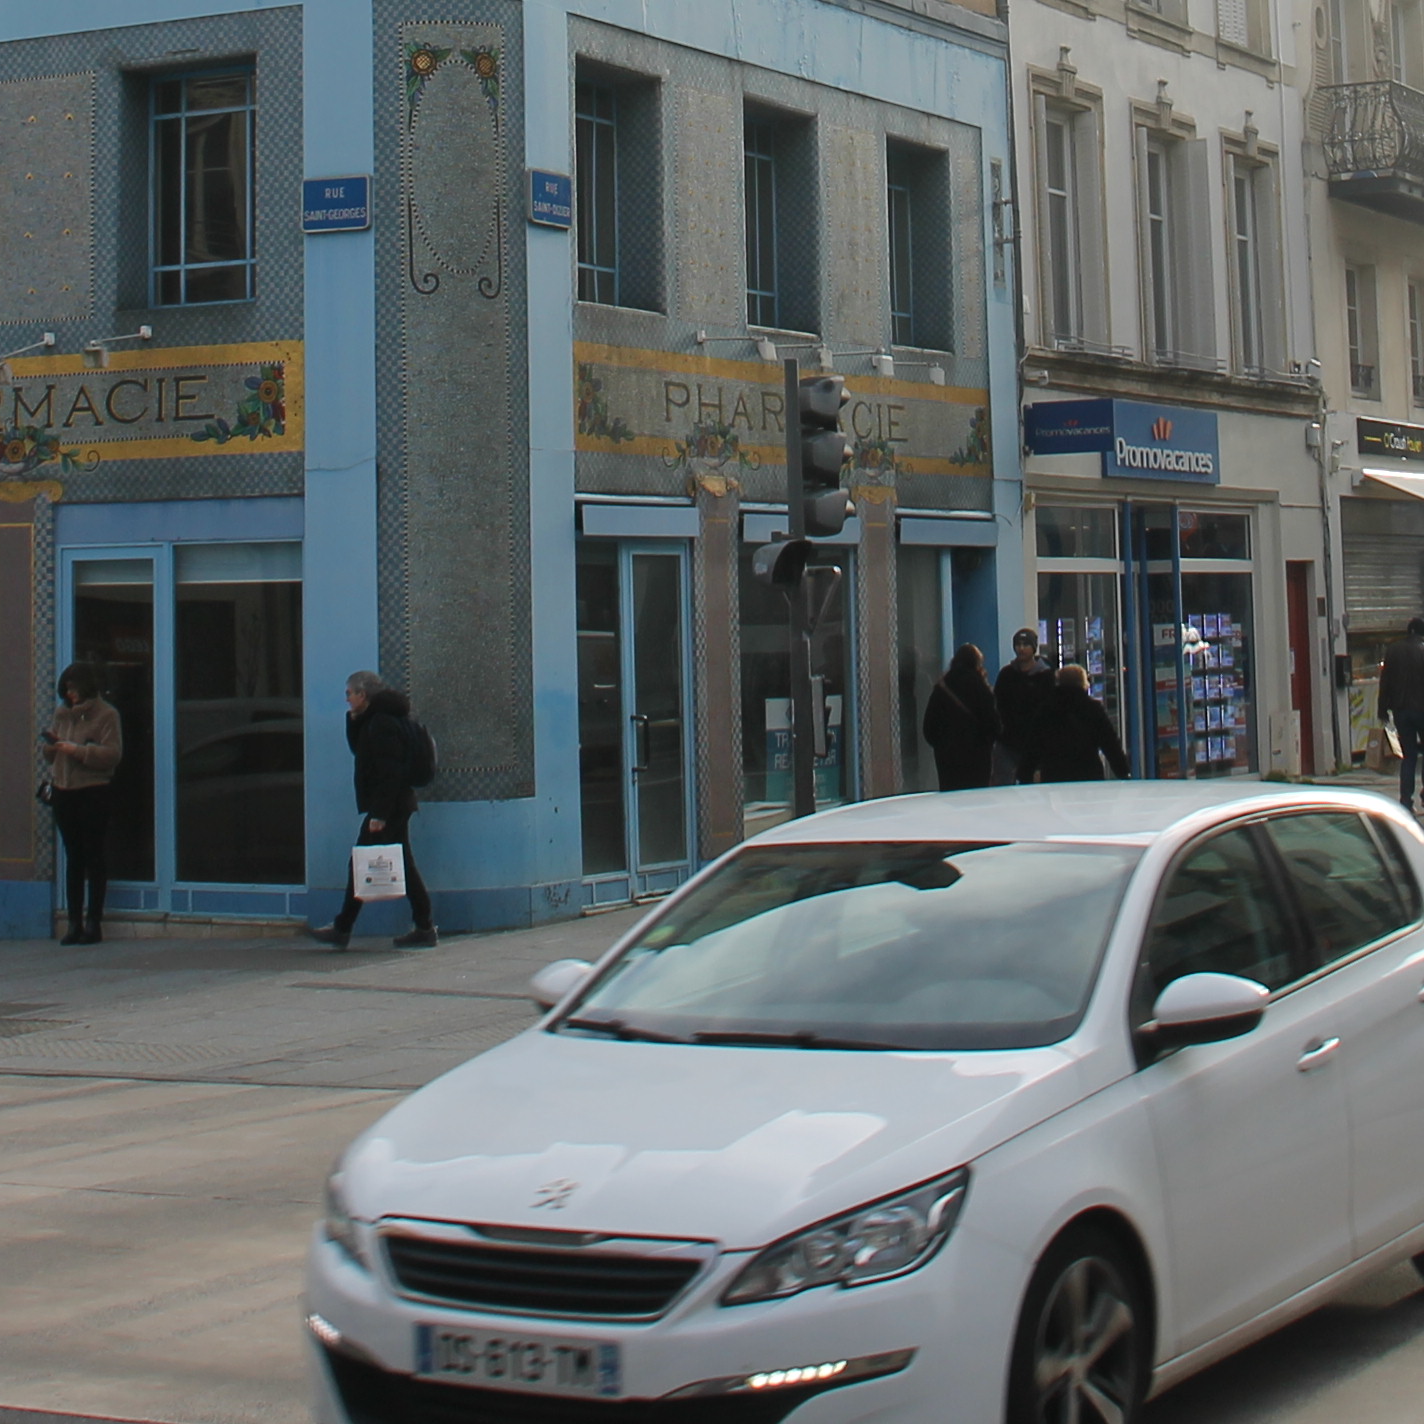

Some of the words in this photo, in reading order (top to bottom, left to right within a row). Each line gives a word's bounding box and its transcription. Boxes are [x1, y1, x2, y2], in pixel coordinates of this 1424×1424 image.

[325, 186, 345, 199] RUE
[545, 181, 558, 195] RUE
[304, 207, 366, 222] SAINT-GEORGES
[663, 379, 909, 442] PHARCIE
[1035, 426, 1112, 438] Promovacances
[1116, 436, 1213, 474] Promovacances
